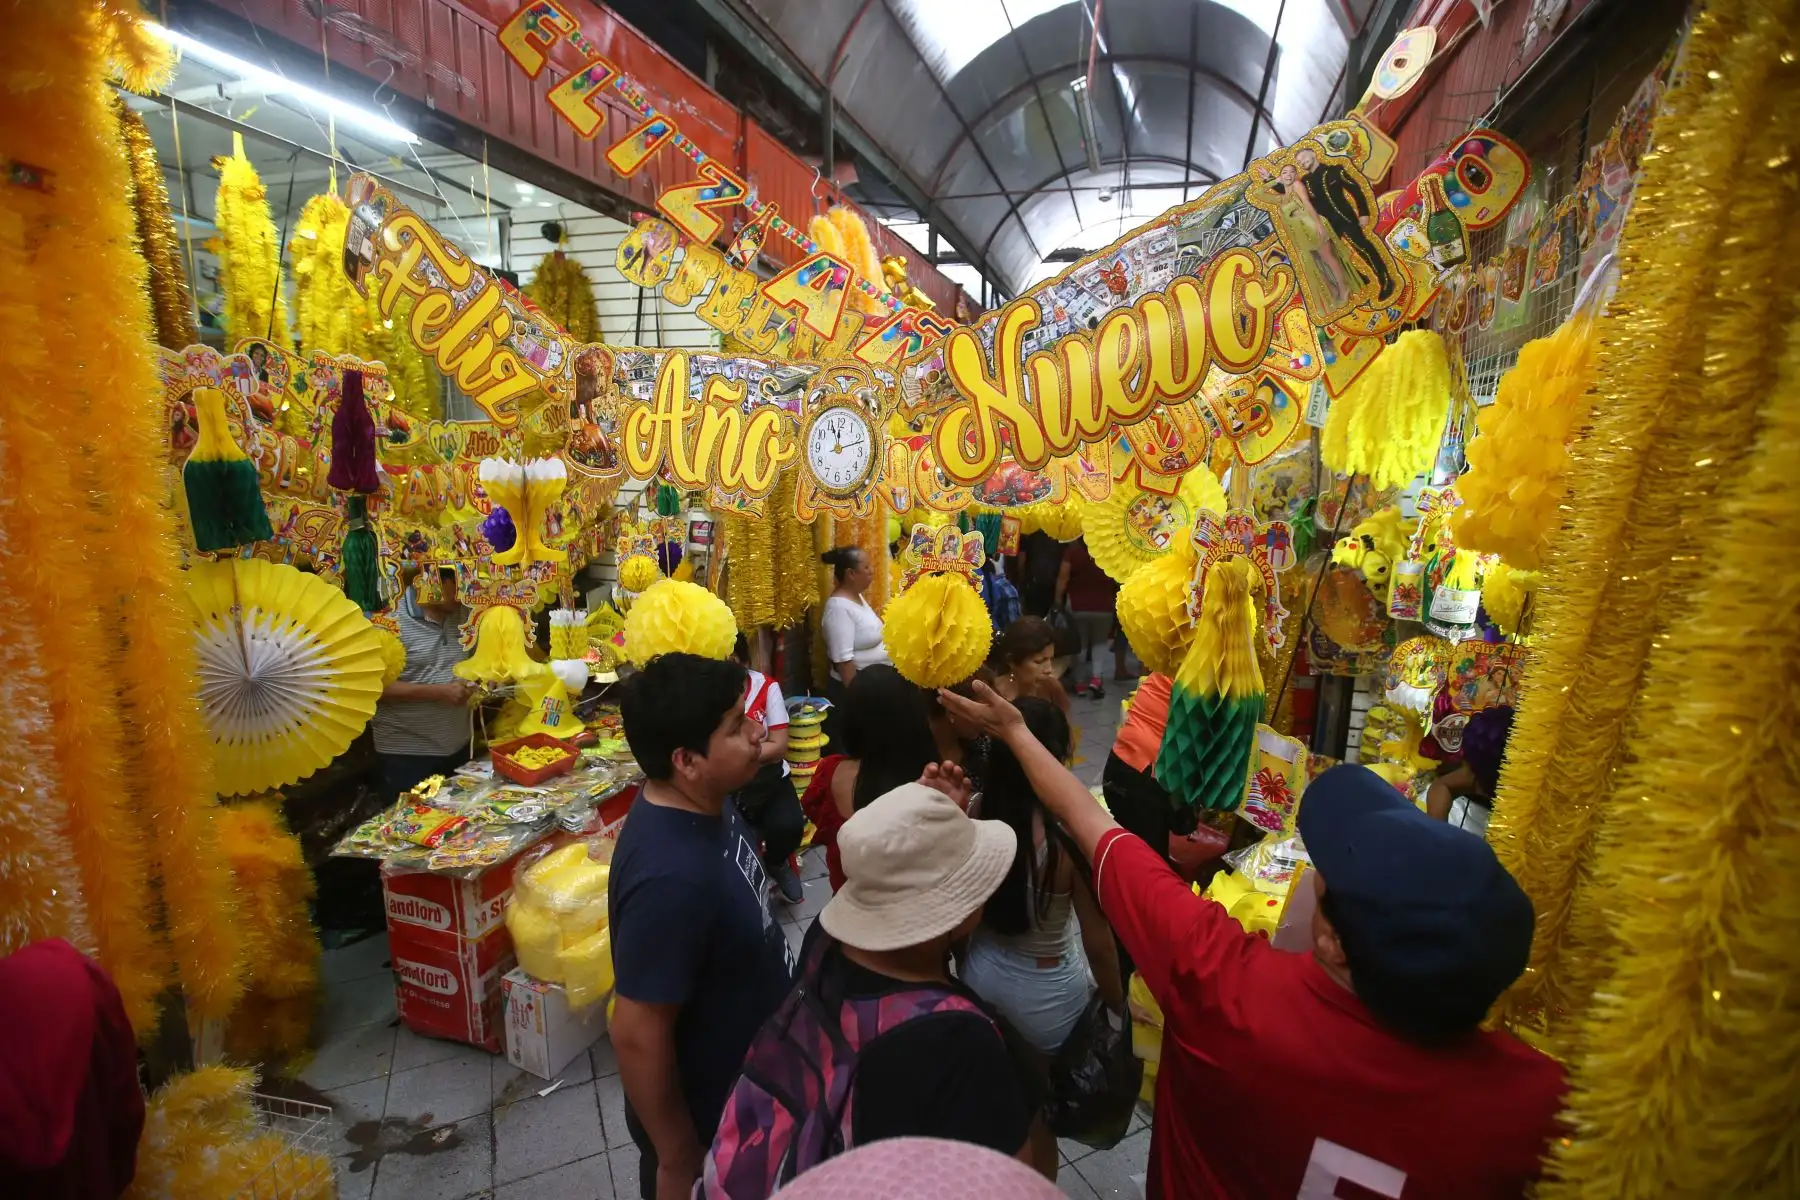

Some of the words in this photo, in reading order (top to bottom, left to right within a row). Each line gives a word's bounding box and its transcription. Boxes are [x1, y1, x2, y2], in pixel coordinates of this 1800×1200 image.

[376, 213, 540, 428] Feliz
[624, 354, 796, 492] Año
[934, 253, 1289, 482] Nuevo
[464, 430, 501, 457] Año
[1224, 539, 1245, 554] Año
[1248, 546, 1276, 586] Nuevo
